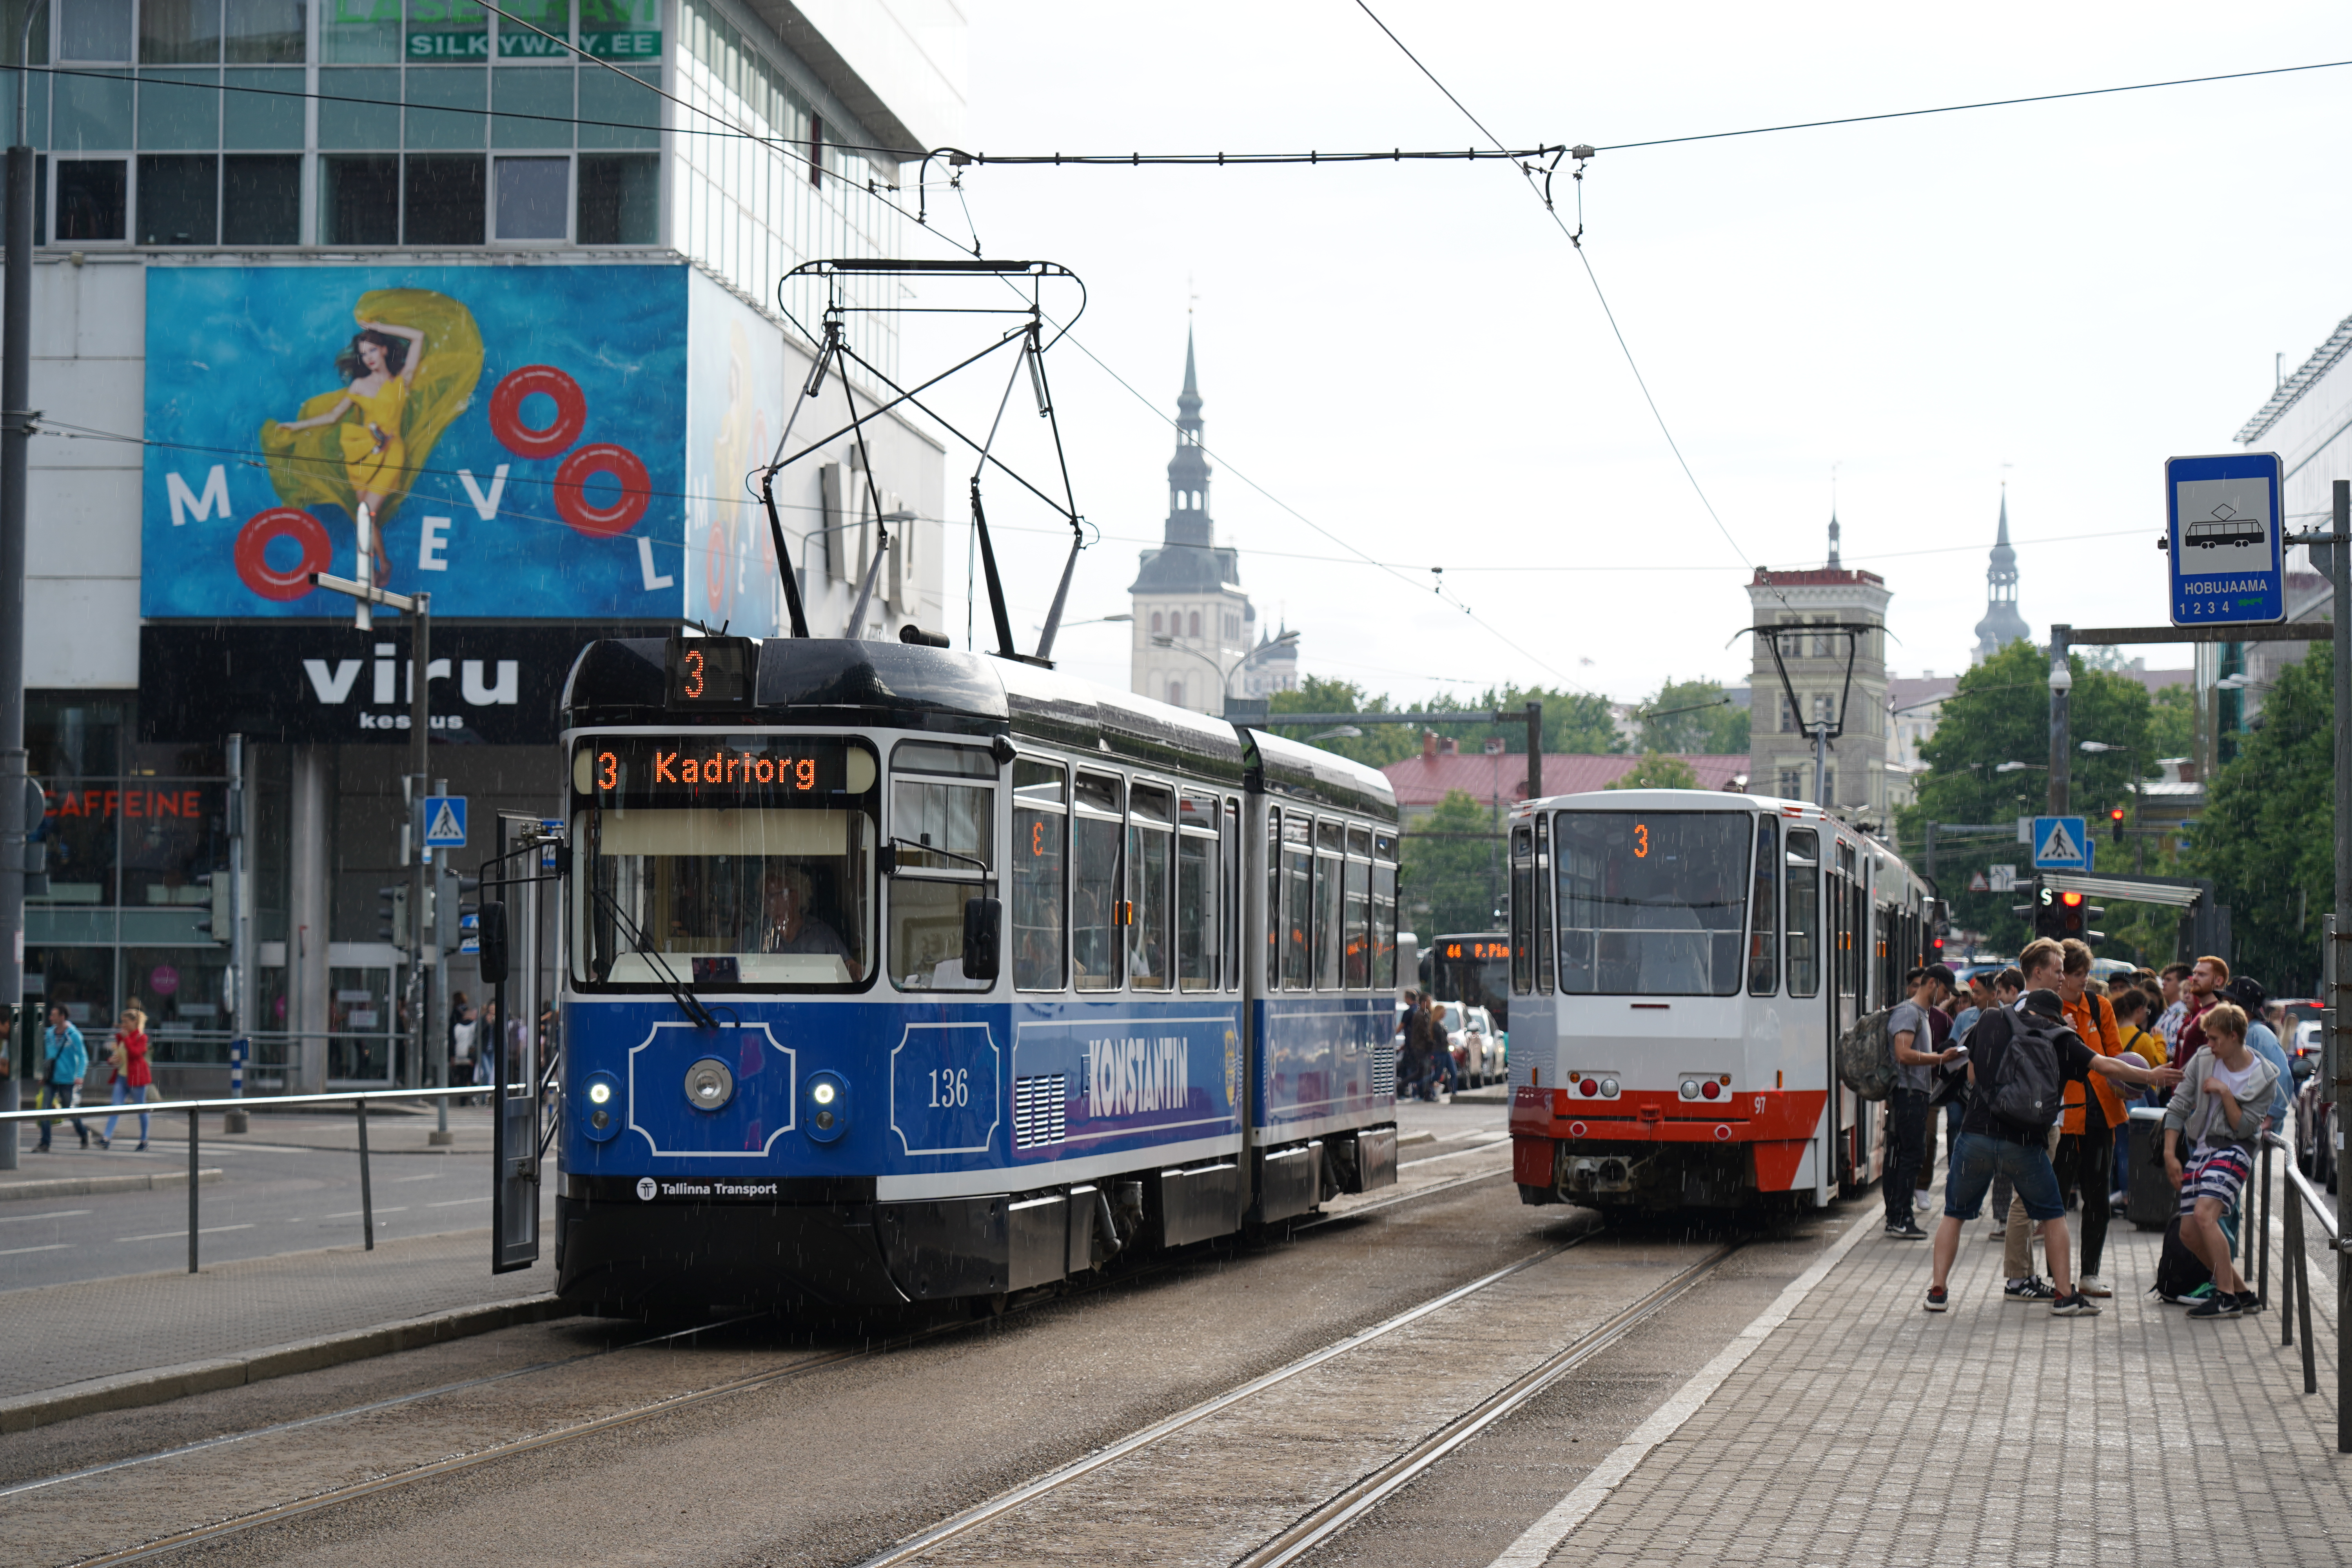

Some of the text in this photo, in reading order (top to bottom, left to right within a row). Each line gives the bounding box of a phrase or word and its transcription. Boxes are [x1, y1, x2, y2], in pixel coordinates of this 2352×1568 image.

[2185, 579, 2268, 595] HOBUJAAMA
[2180, 601, 2229, 615] 1 2 3 4
[302, 643, 519, 706] viru
[685, 650, 704, 698] 3
[359, 711, 464, 730] kesus
[598, 751, 816, 790] 3 Kadriorg
[1634, 824, 1649, 858] 3
[928, 1068, 968, 1108] 136
[1089, 1037, 1188, 1118] KONSTANTIN
[1754, 1096, 1766, 1114] 97
[661, 1183, 777, 1197] Tallinna Transport
